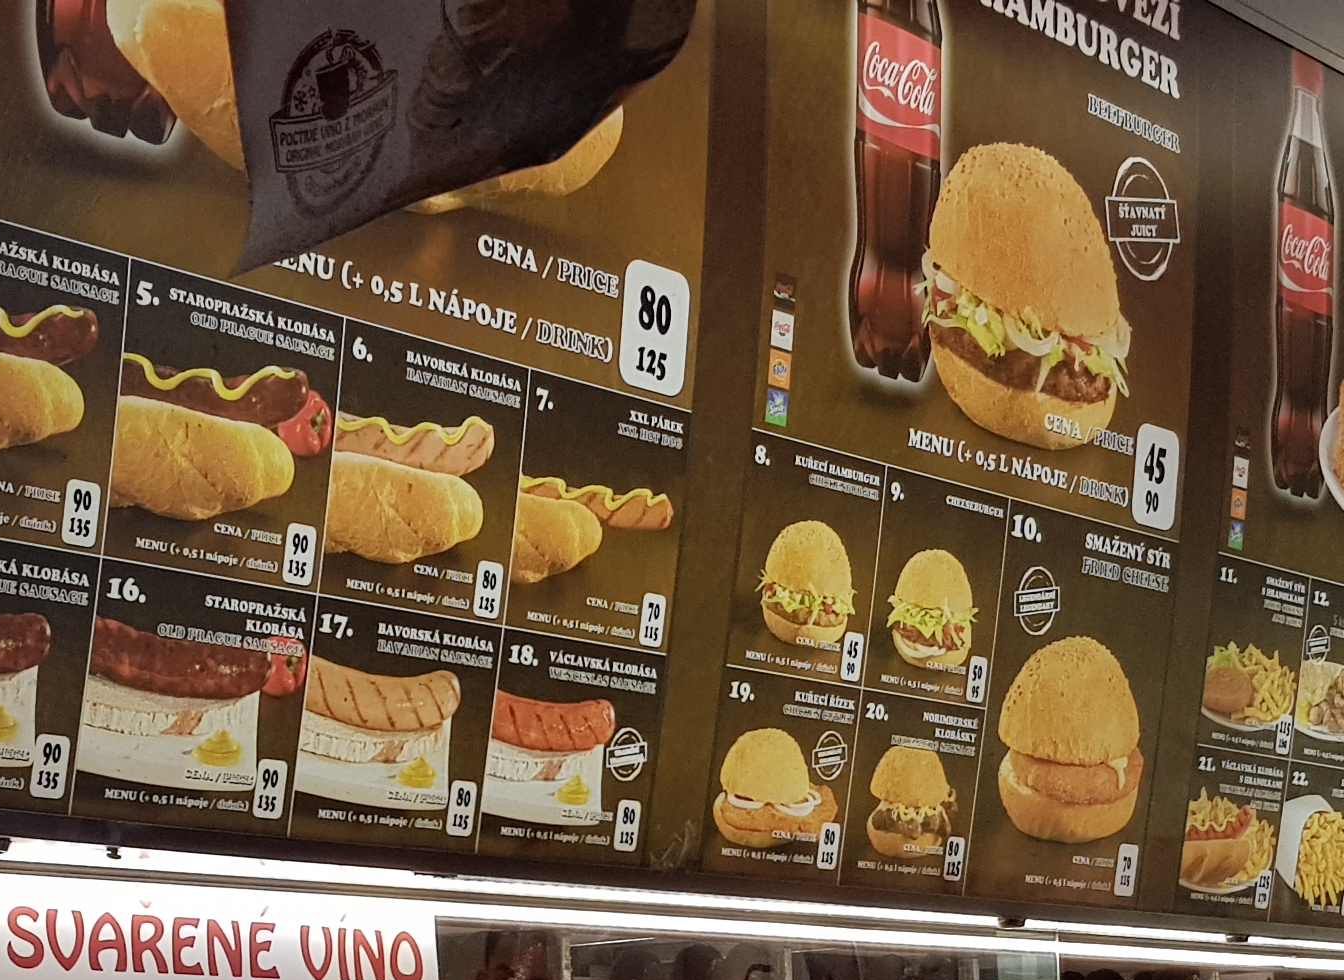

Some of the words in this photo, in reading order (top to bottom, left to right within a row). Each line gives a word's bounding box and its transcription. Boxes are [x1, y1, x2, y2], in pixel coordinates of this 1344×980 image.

[980, 0, 1180, 98] AMBURGER
[863, 40, 938, 118] Coca-Cola
[1088, 93, 1181, 153] BEEFBURGER
[52, 255, 119, 285] KLOBÁSA
[477, 233, 539, 274] CENA
[558, 257, 620, 299] PRICE
[1280, 222, 1330, 282] Coca-Cola
[50, 275, 119, 304] SAUSAGE
[273, 252, 336, 280] ENU
[370, 274, 403, 305] 0,5
[408, 281, 424, 307] L
[428, 287, 518, 336] NÁPOJE
[535, 318, 613, 363] DRINK)
[135, 282, 160, 306] 5.
[169, 287, 274, 332] STAROPRAŽSKÁ
[277, 315, 335, 344] KLOBÁSA
[638, 285, 672, 336] 80
[190, 311, 218, 331] OLD
[220, 317, 274, 346] PRAGUE
[276, 333, 335, 362] SAUSAGE
[352, 337, 373, 363] 6.
[406, 350, 468, 380] BAVORSKÁ
[470, 367, 522, 393] KLOBÁSA
[635, 346, 668, 381] 125
[535, 387, 553, 412] 7.
[629, 410, 649, 429] XXL
[650, 413, 684, 434] PÁREK
[1043, 413, 1082, 440] CENA
[1093, 428, 1134, 455] PRICE
[754, 445, 771, 467] 8.
[795, 454, 828, 475] KUŘECÍ
[828, 462, 880, 486] HAMBURGER
[909, 428, 954, 458] MENU
[975, 449, 996, 472] 0,5
[999, 455, 1009, 474] L
[1010, 457, 1068, 490] NÁPOJE
[1143, 441, 1166, 484] 45
[73, 488, 92, 513] 90
[890, 481, 905, 501] 9.
[945, 494, 1004, 519] CHEESEBURGER
[1145, 492, 1160, 514] 90
[69, 516, 90, 538] 135
[1011, 514, 1042, 543] 10.
[1085, 529, 1145, 563] SMAŽENÝ
[1146, 545, 1171, 569] SÝR
[21, 562, 90, 587] KLOBÁSA
[106, 576, 146, 604] 16.
[481, 569, 497, 591] 80
[1082, 556, 1120, 583] FRIED
[1122, 569, 1170, 593] CHEESE
[1219, 566, 1238, 585] 11.
[204, 594, 306, 623] STAROPRAŽSKÁ
[478, 595, 496, 614] 125
[245, 618, 304, 640] KLOBÁSA
[319, 613, 353, 639] 17.
[378, 621, 440, 647] BAVORSKÁ
[442, 633, 494, 653] KLOBÁSA
[508, 643, 539, 668] 18.
[549, 649, 610, 672] VÁCLAVSKÁ
[611, 660, 657, 679] KLOBÁSA
[972, 665, 983, 682] 50
[729, 681, 755, 703] 19.
[865, 702, 888, 721] 20.
[7, 901, 279, 980] SVAŘENÉ
